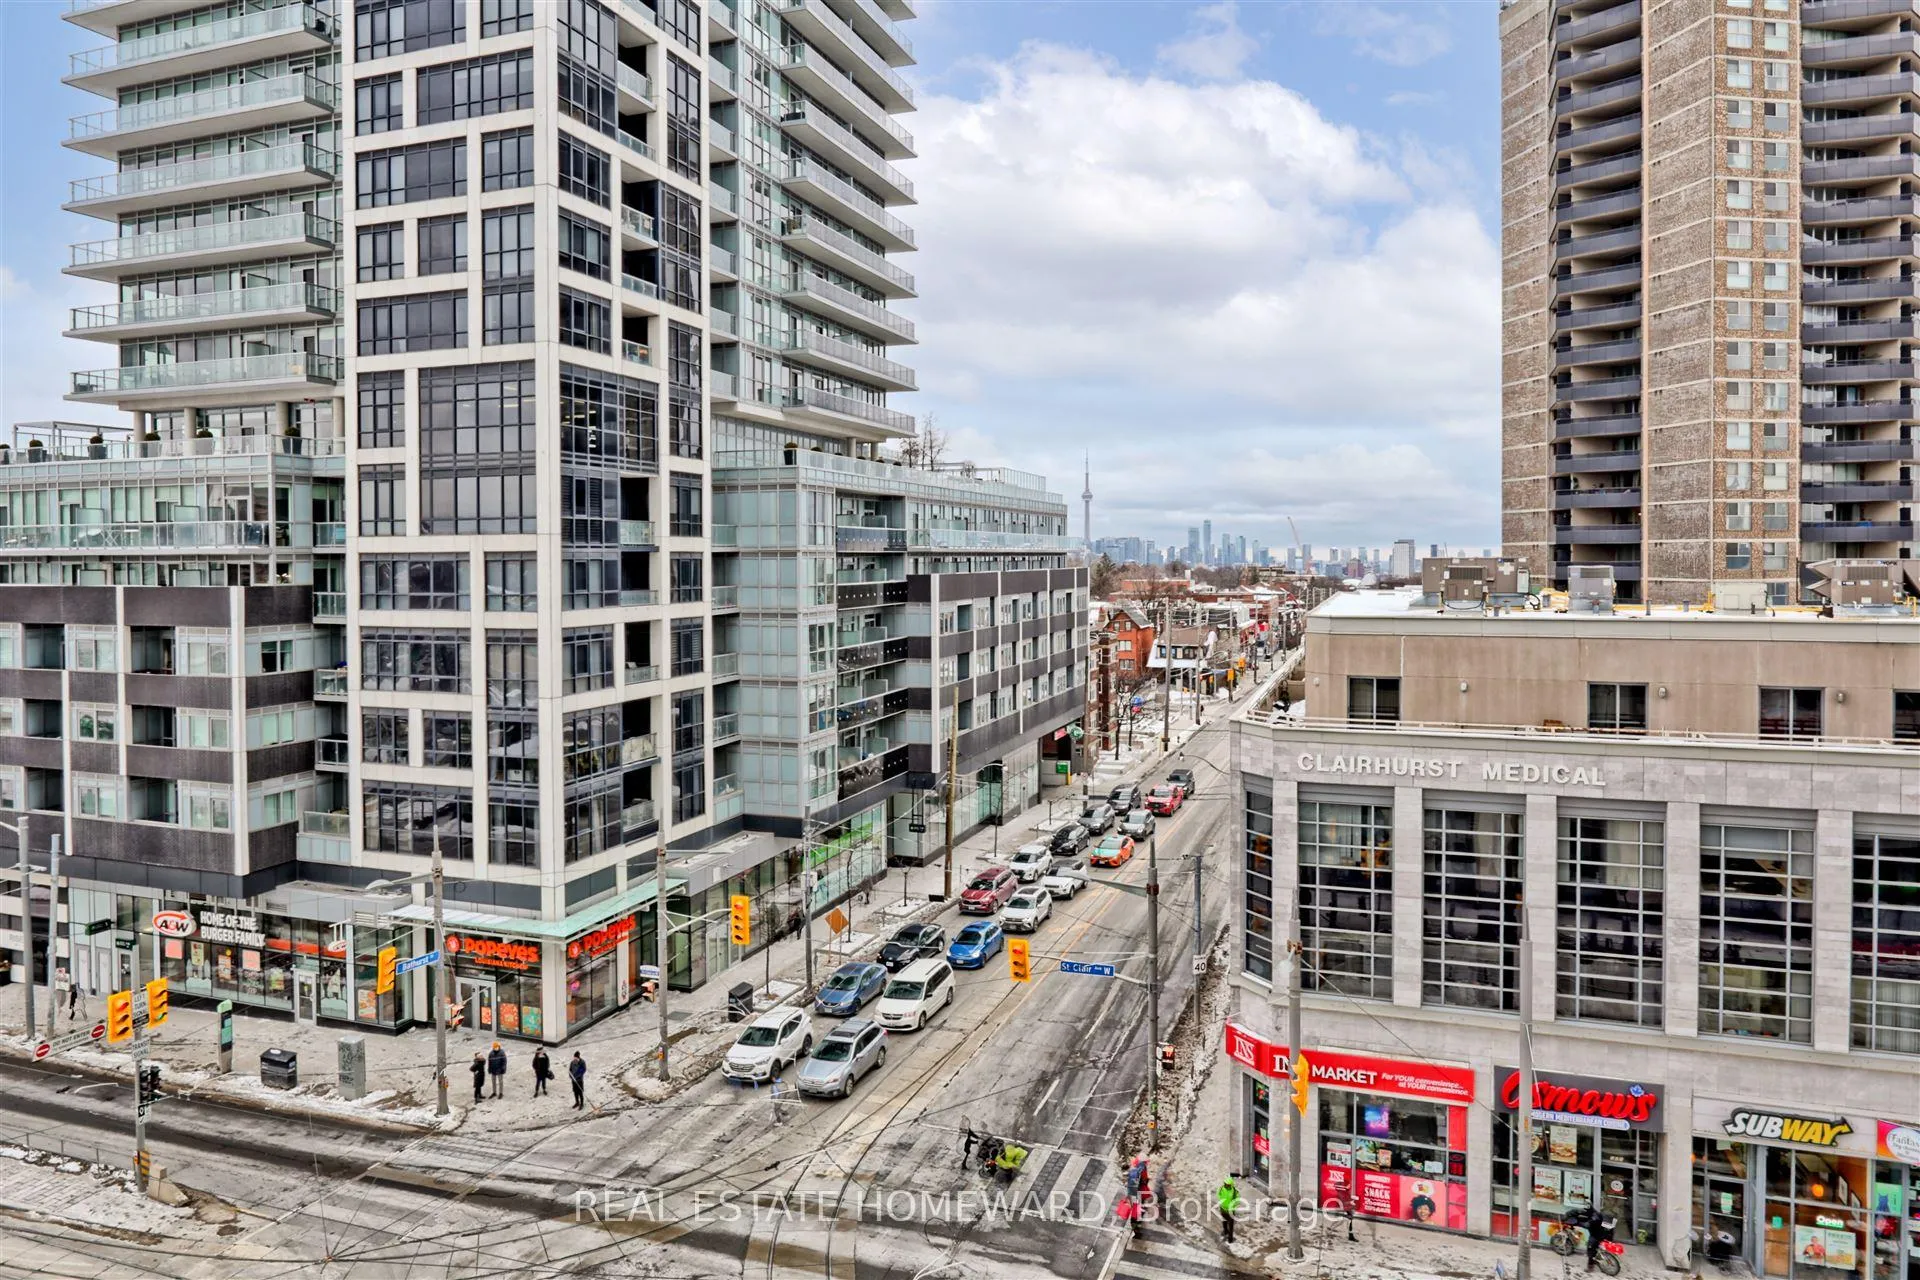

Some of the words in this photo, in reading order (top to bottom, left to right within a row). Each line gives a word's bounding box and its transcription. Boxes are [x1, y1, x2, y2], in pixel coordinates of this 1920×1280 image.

[1297, 752, 1463, 778] CLAIRHURST
[1482, 762, 1607, 786] MEDICAL
[200, 910, 225, 926] HOME
[225, 914, 238, 928] OF
[238, 916, 259, 931] THE
[201, 926, 235, 943] BURGER
[235, 929, 266, 947] FAMILY
[1061, 962, 1070, 970] St
[1073, 963, 1092, 973] Clair
[1103, 966, 1111, 975] W
[1194, 962, 1206, 971] 40
[1312, 1064, 1377, 1085] MARKET
[1382, 1072, 1394, 1081] For
[1395, 1074, 1415, 1083] YOUR
[1407, 1082, 1427, 1091] YOUR
[1724, 1110, 1852, 1146] SUBWAY
[1364, 1186, 1391, 1200] SNACK
